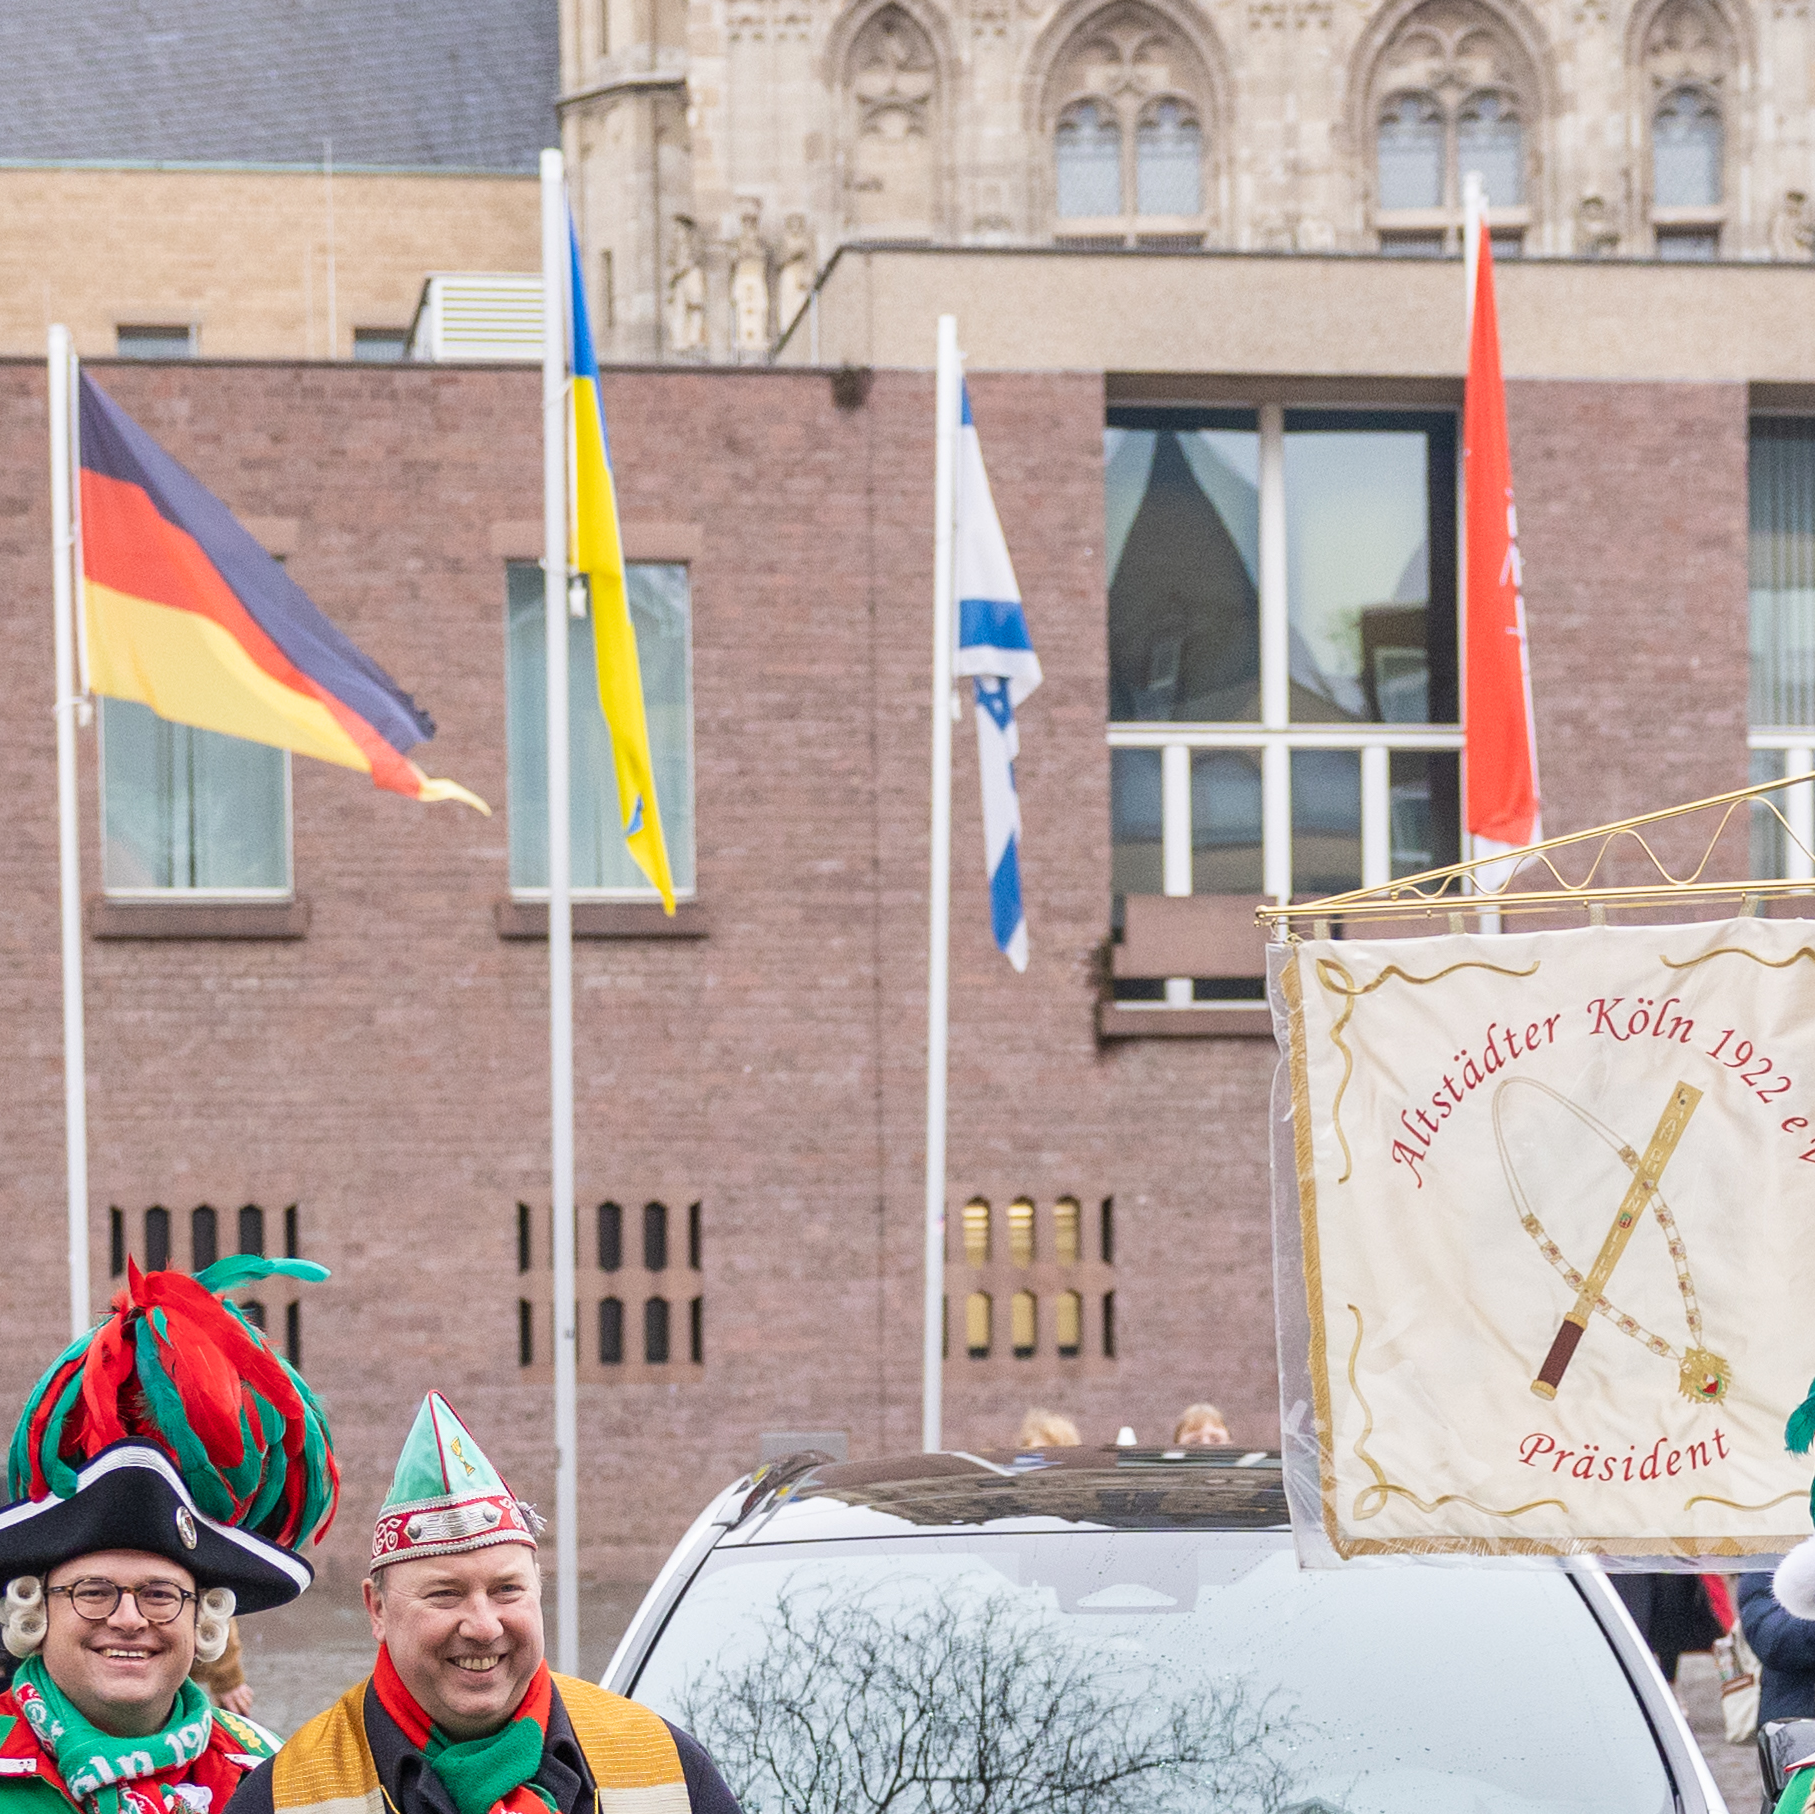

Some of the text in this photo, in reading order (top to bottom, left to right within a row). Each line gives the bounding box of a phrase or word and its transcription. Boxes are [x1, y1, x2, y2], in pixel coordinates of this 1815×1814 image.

[1390, 1011, 1561, 1189] Altstädter
[1586, 997, 1694, 1044] Köln
[1706, 1027, 1792, 1105] 1922
[1519, 1426, 1732, 1482] Präsident
